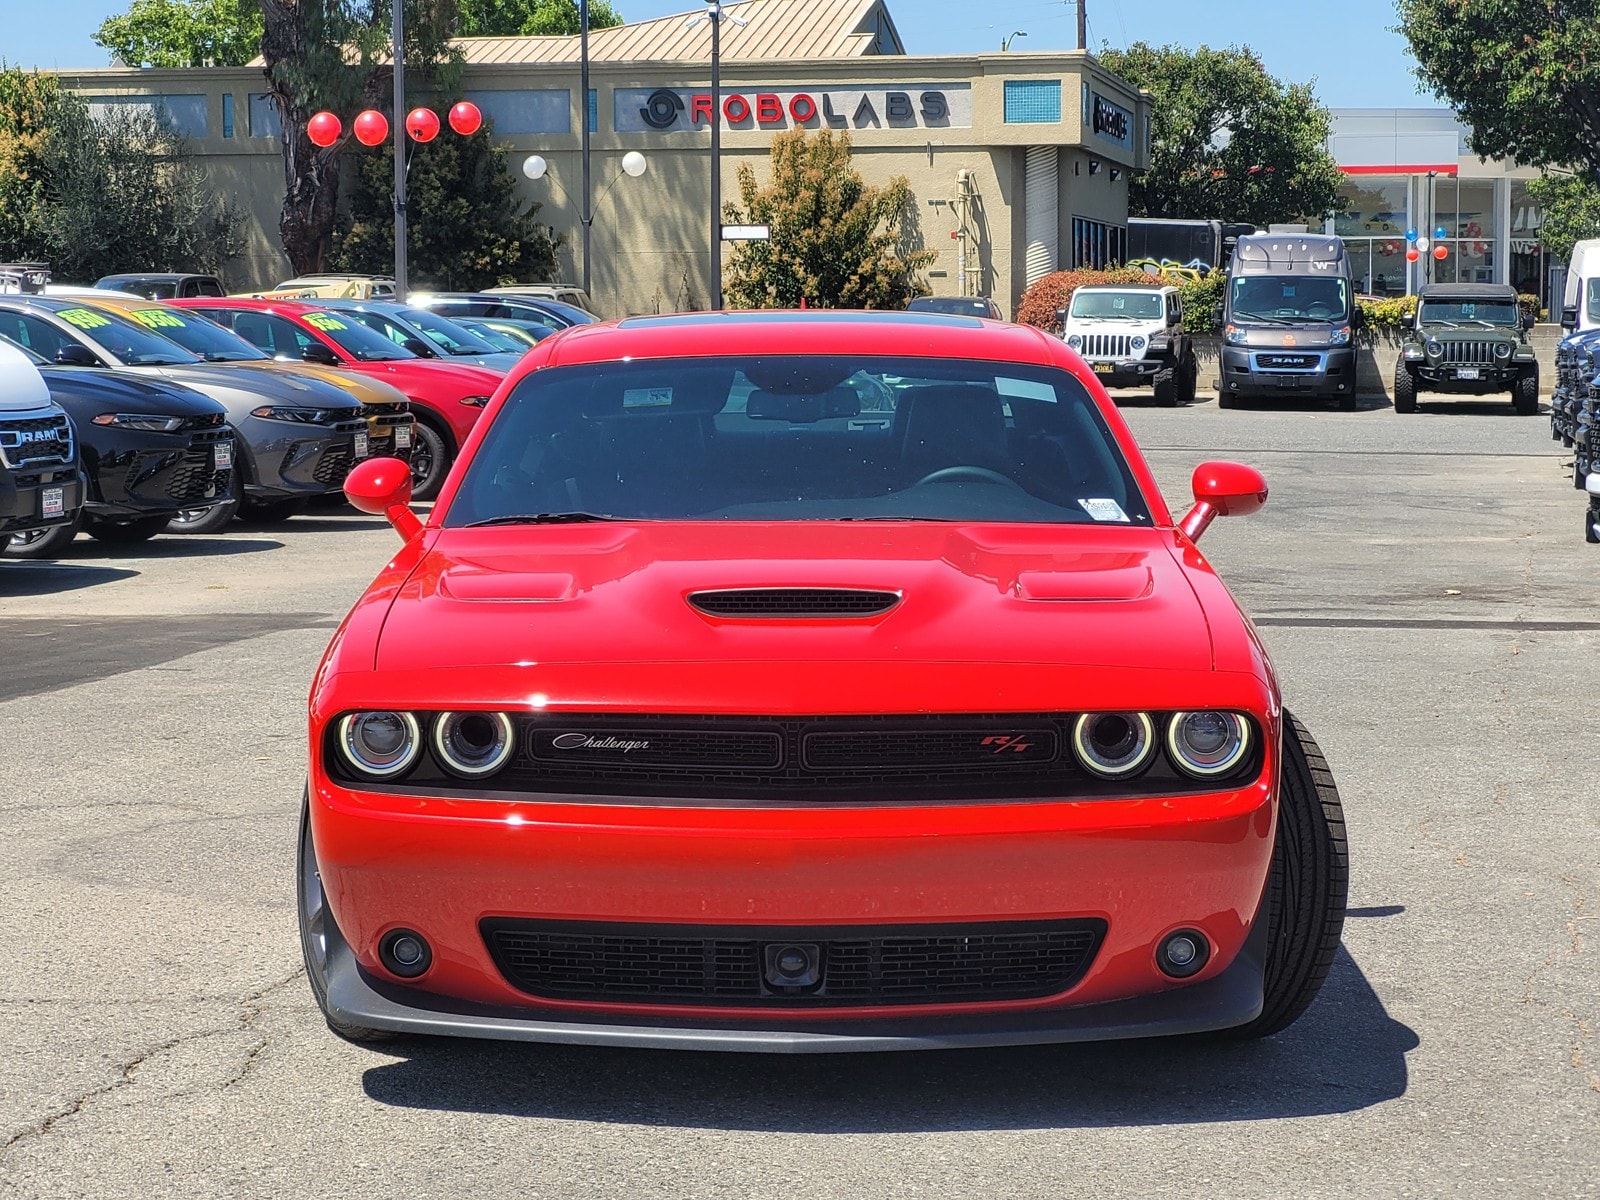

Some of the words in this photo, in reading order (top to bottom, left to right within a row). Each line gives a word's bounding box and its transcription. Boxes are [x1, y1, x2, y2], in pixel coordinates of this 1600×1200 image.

[691, 91, 947, 123] ROBOLABS
[21, 429, 56, 443] RAM
[552, 733, 649, 753] Challenger
[980, 735, 1035, 754] R/T
